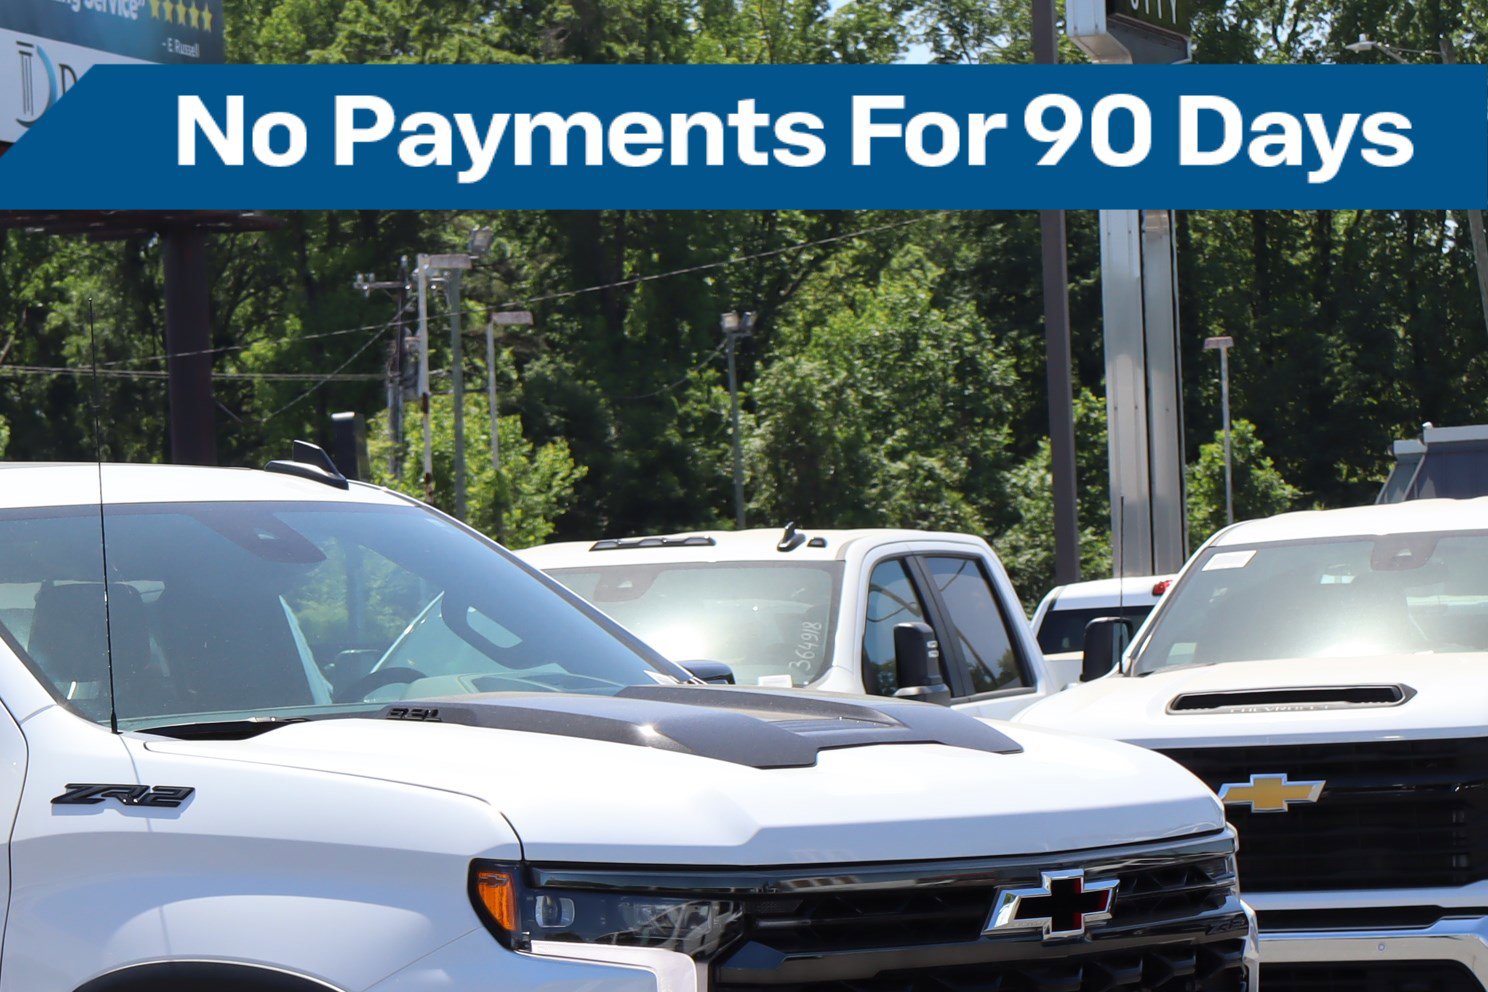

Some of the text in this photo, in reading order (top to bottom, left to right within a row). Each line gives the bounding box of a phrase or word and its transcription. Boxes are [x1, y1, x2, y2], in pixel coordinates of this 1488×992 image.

[175, 39, 200, 58] Russell
[788, 621, 823, 671] 364918
[51, 783, 196, 808] ZR2
